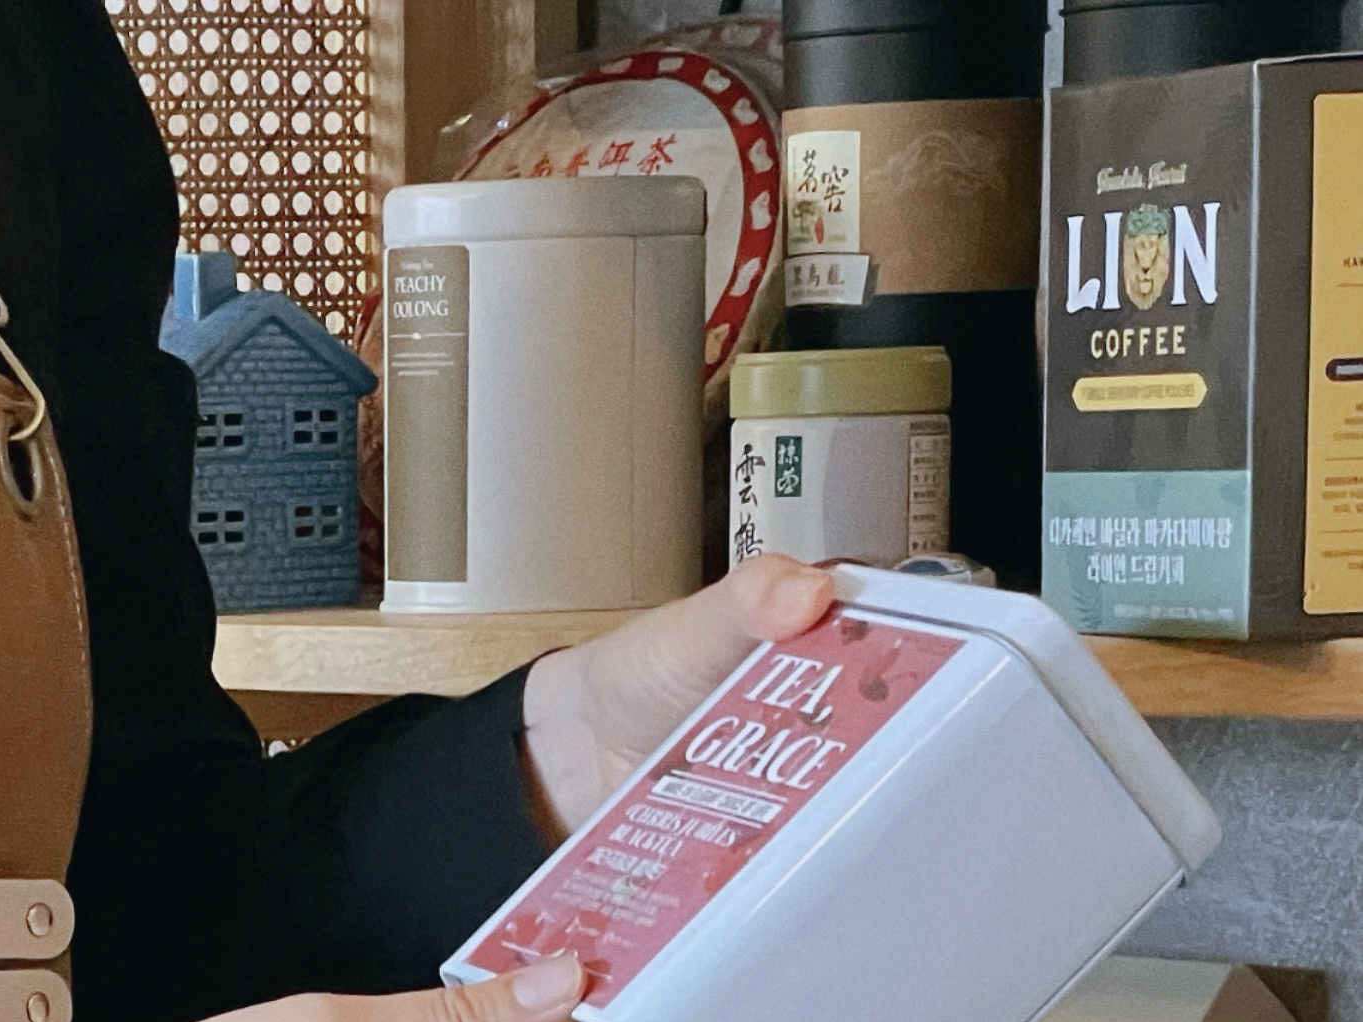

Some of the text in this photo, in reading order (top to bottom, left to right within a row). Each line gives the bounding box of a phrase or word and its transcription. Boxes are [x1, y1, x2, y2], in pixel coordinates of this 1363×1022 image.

[394, 275, 446, 293] PEACHY
[392, 300, 449, 318] OOLONG
[1091, 325, 1186, 359] COFFEE
[1100, 516, 1141, 548] 바닐라
[1087, 552, 1184, 585] 라이언 드립커피
[685, 715, 847, 790] GRACE
